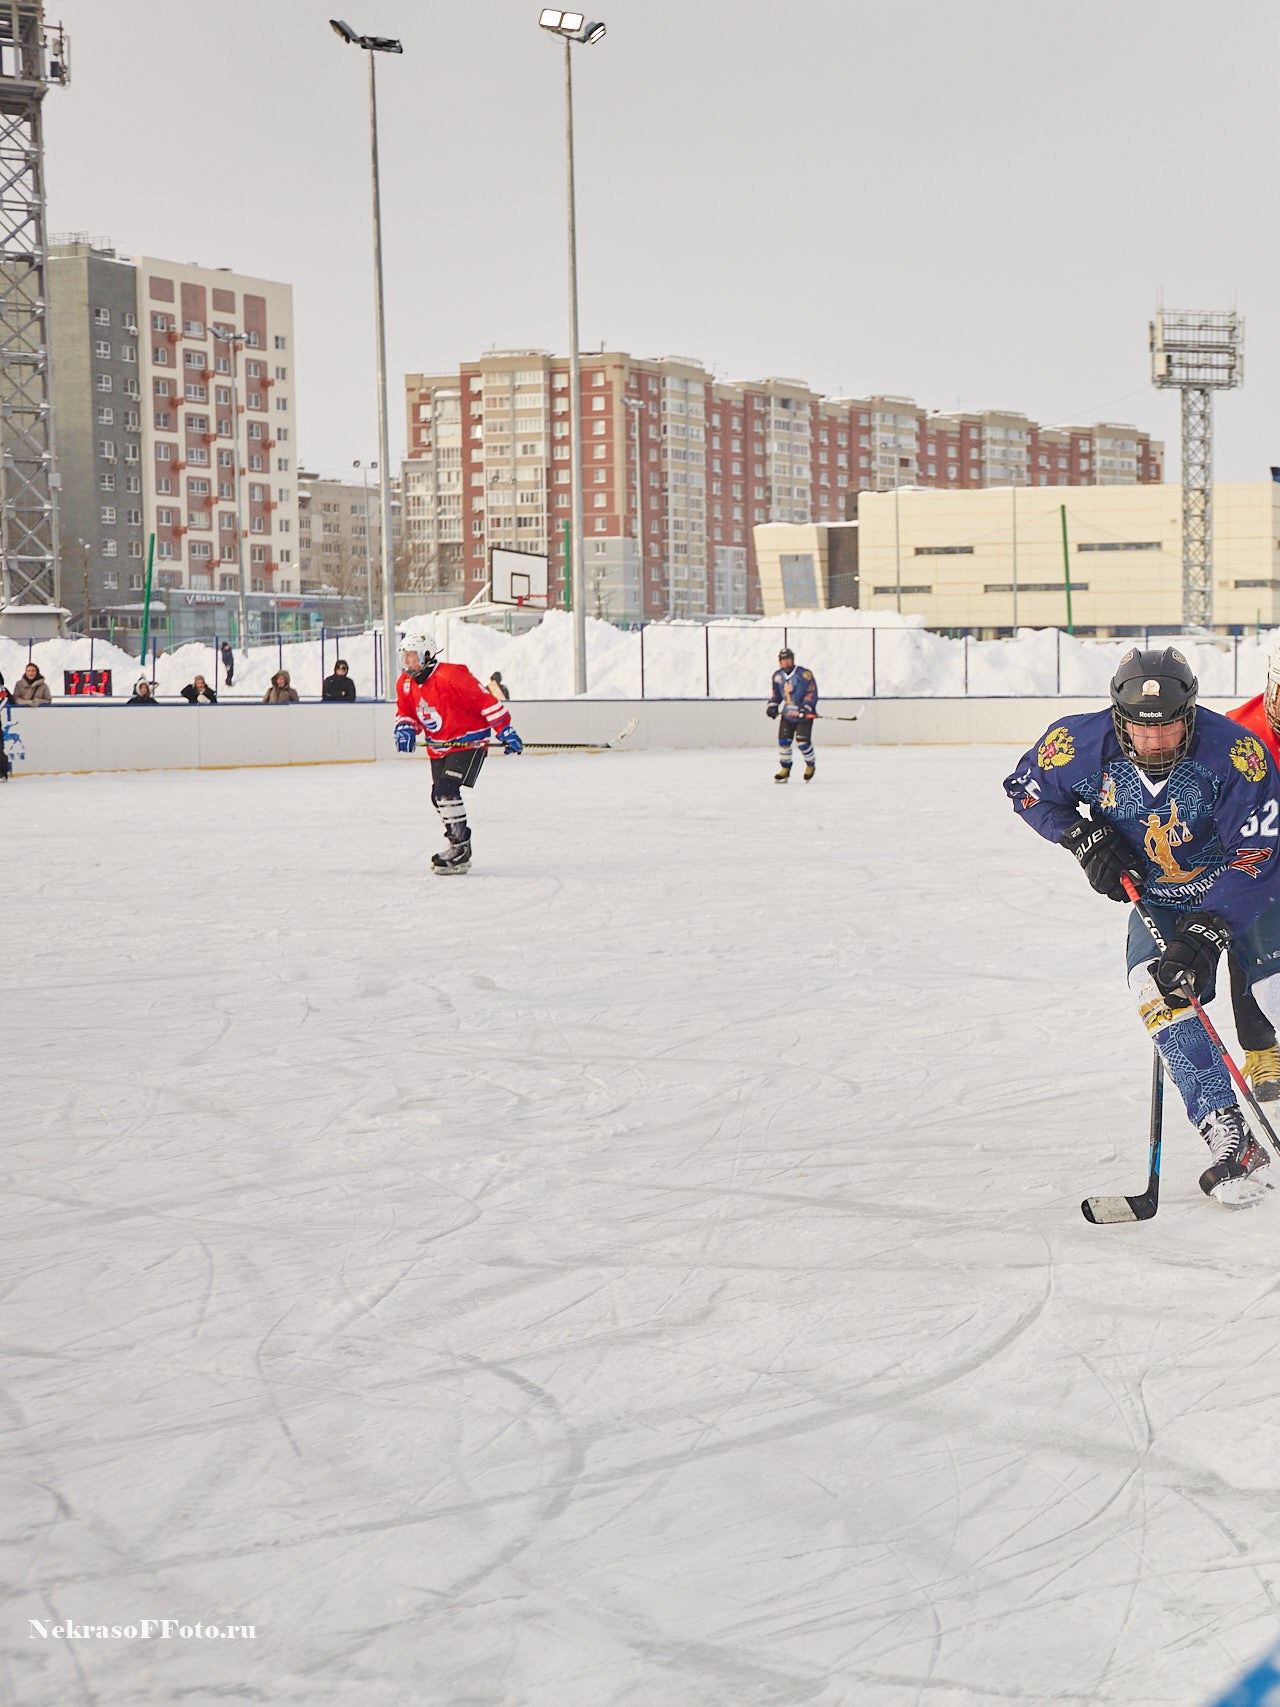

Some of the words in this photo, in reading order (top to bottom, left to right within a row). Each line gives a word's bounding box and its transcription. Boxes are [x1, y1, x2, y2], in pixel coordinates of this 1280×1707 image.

[1240, 798, 1279, 838] 32
[1075, 825, 1115, 861] AUER
[1143, 916, 1168, 952] CCM
